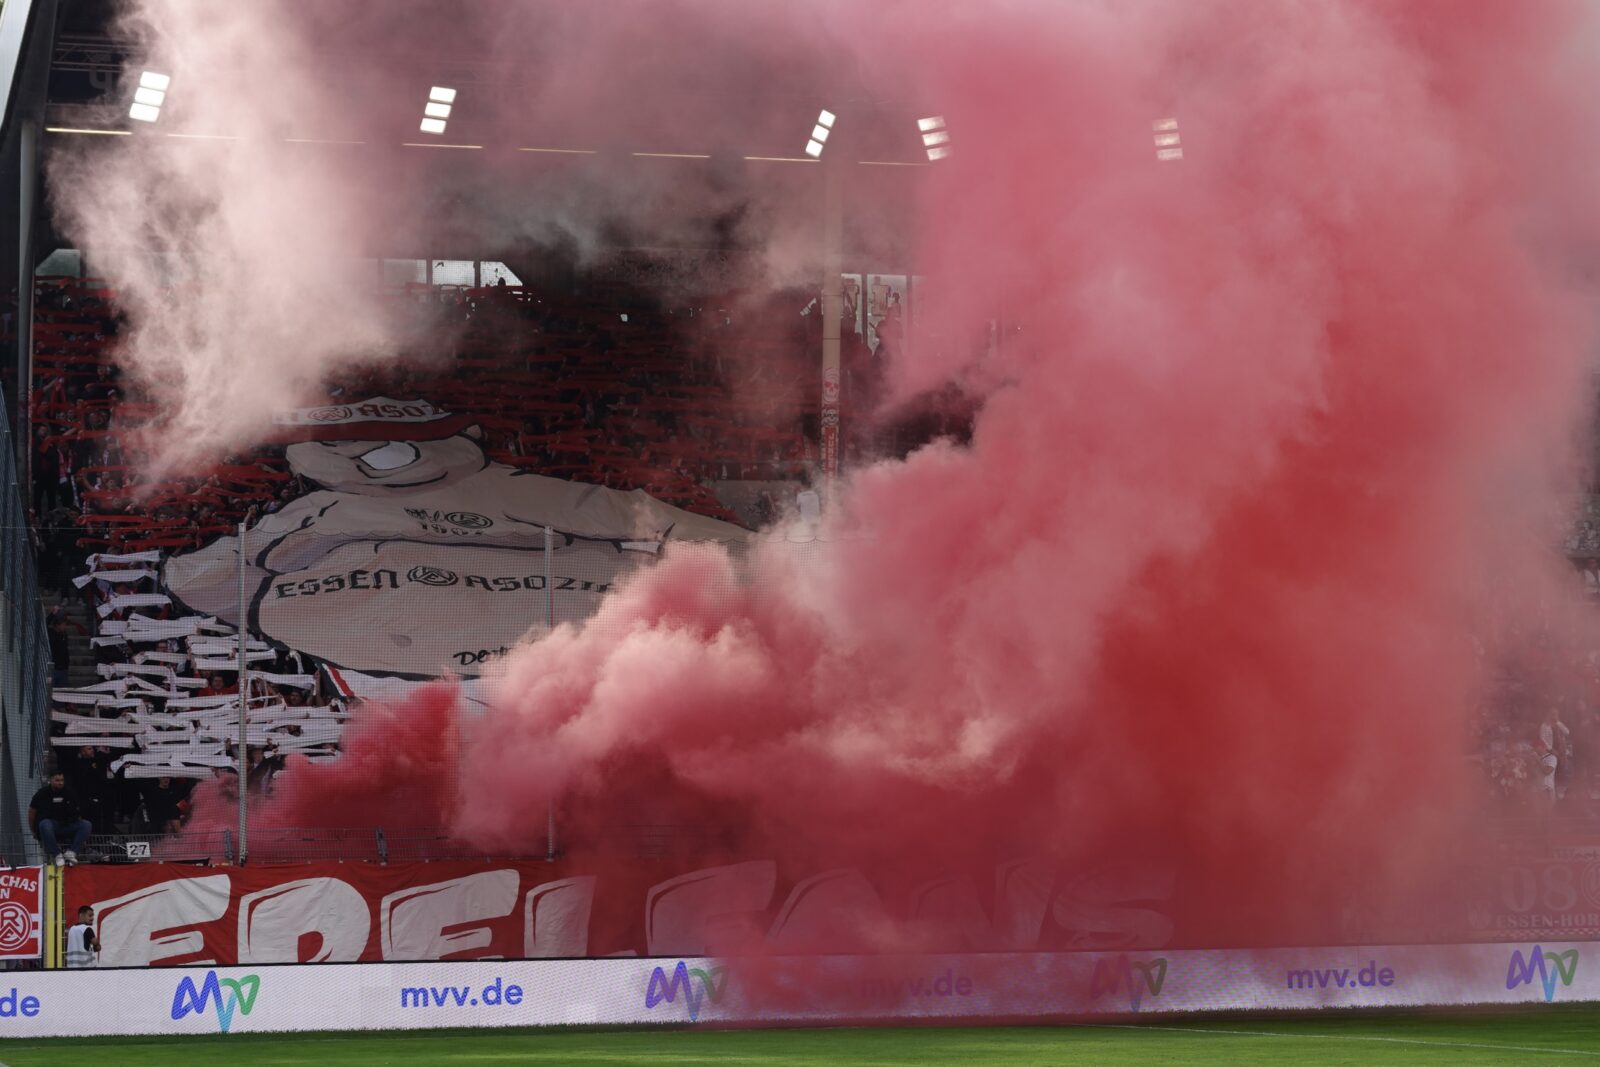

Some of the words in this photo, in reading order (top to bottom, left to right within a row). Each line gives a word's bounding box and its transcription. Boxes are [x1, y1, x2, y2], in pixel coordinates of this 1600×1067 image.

[275, 569, 400, 599] ESSEN
[129, 844, 148, 856] 27
[401, 977, 524, 1008] mvv.de
[861, 968, 974, 999] mvv.de
[1287, 960, 1396, 989] mvv.de
